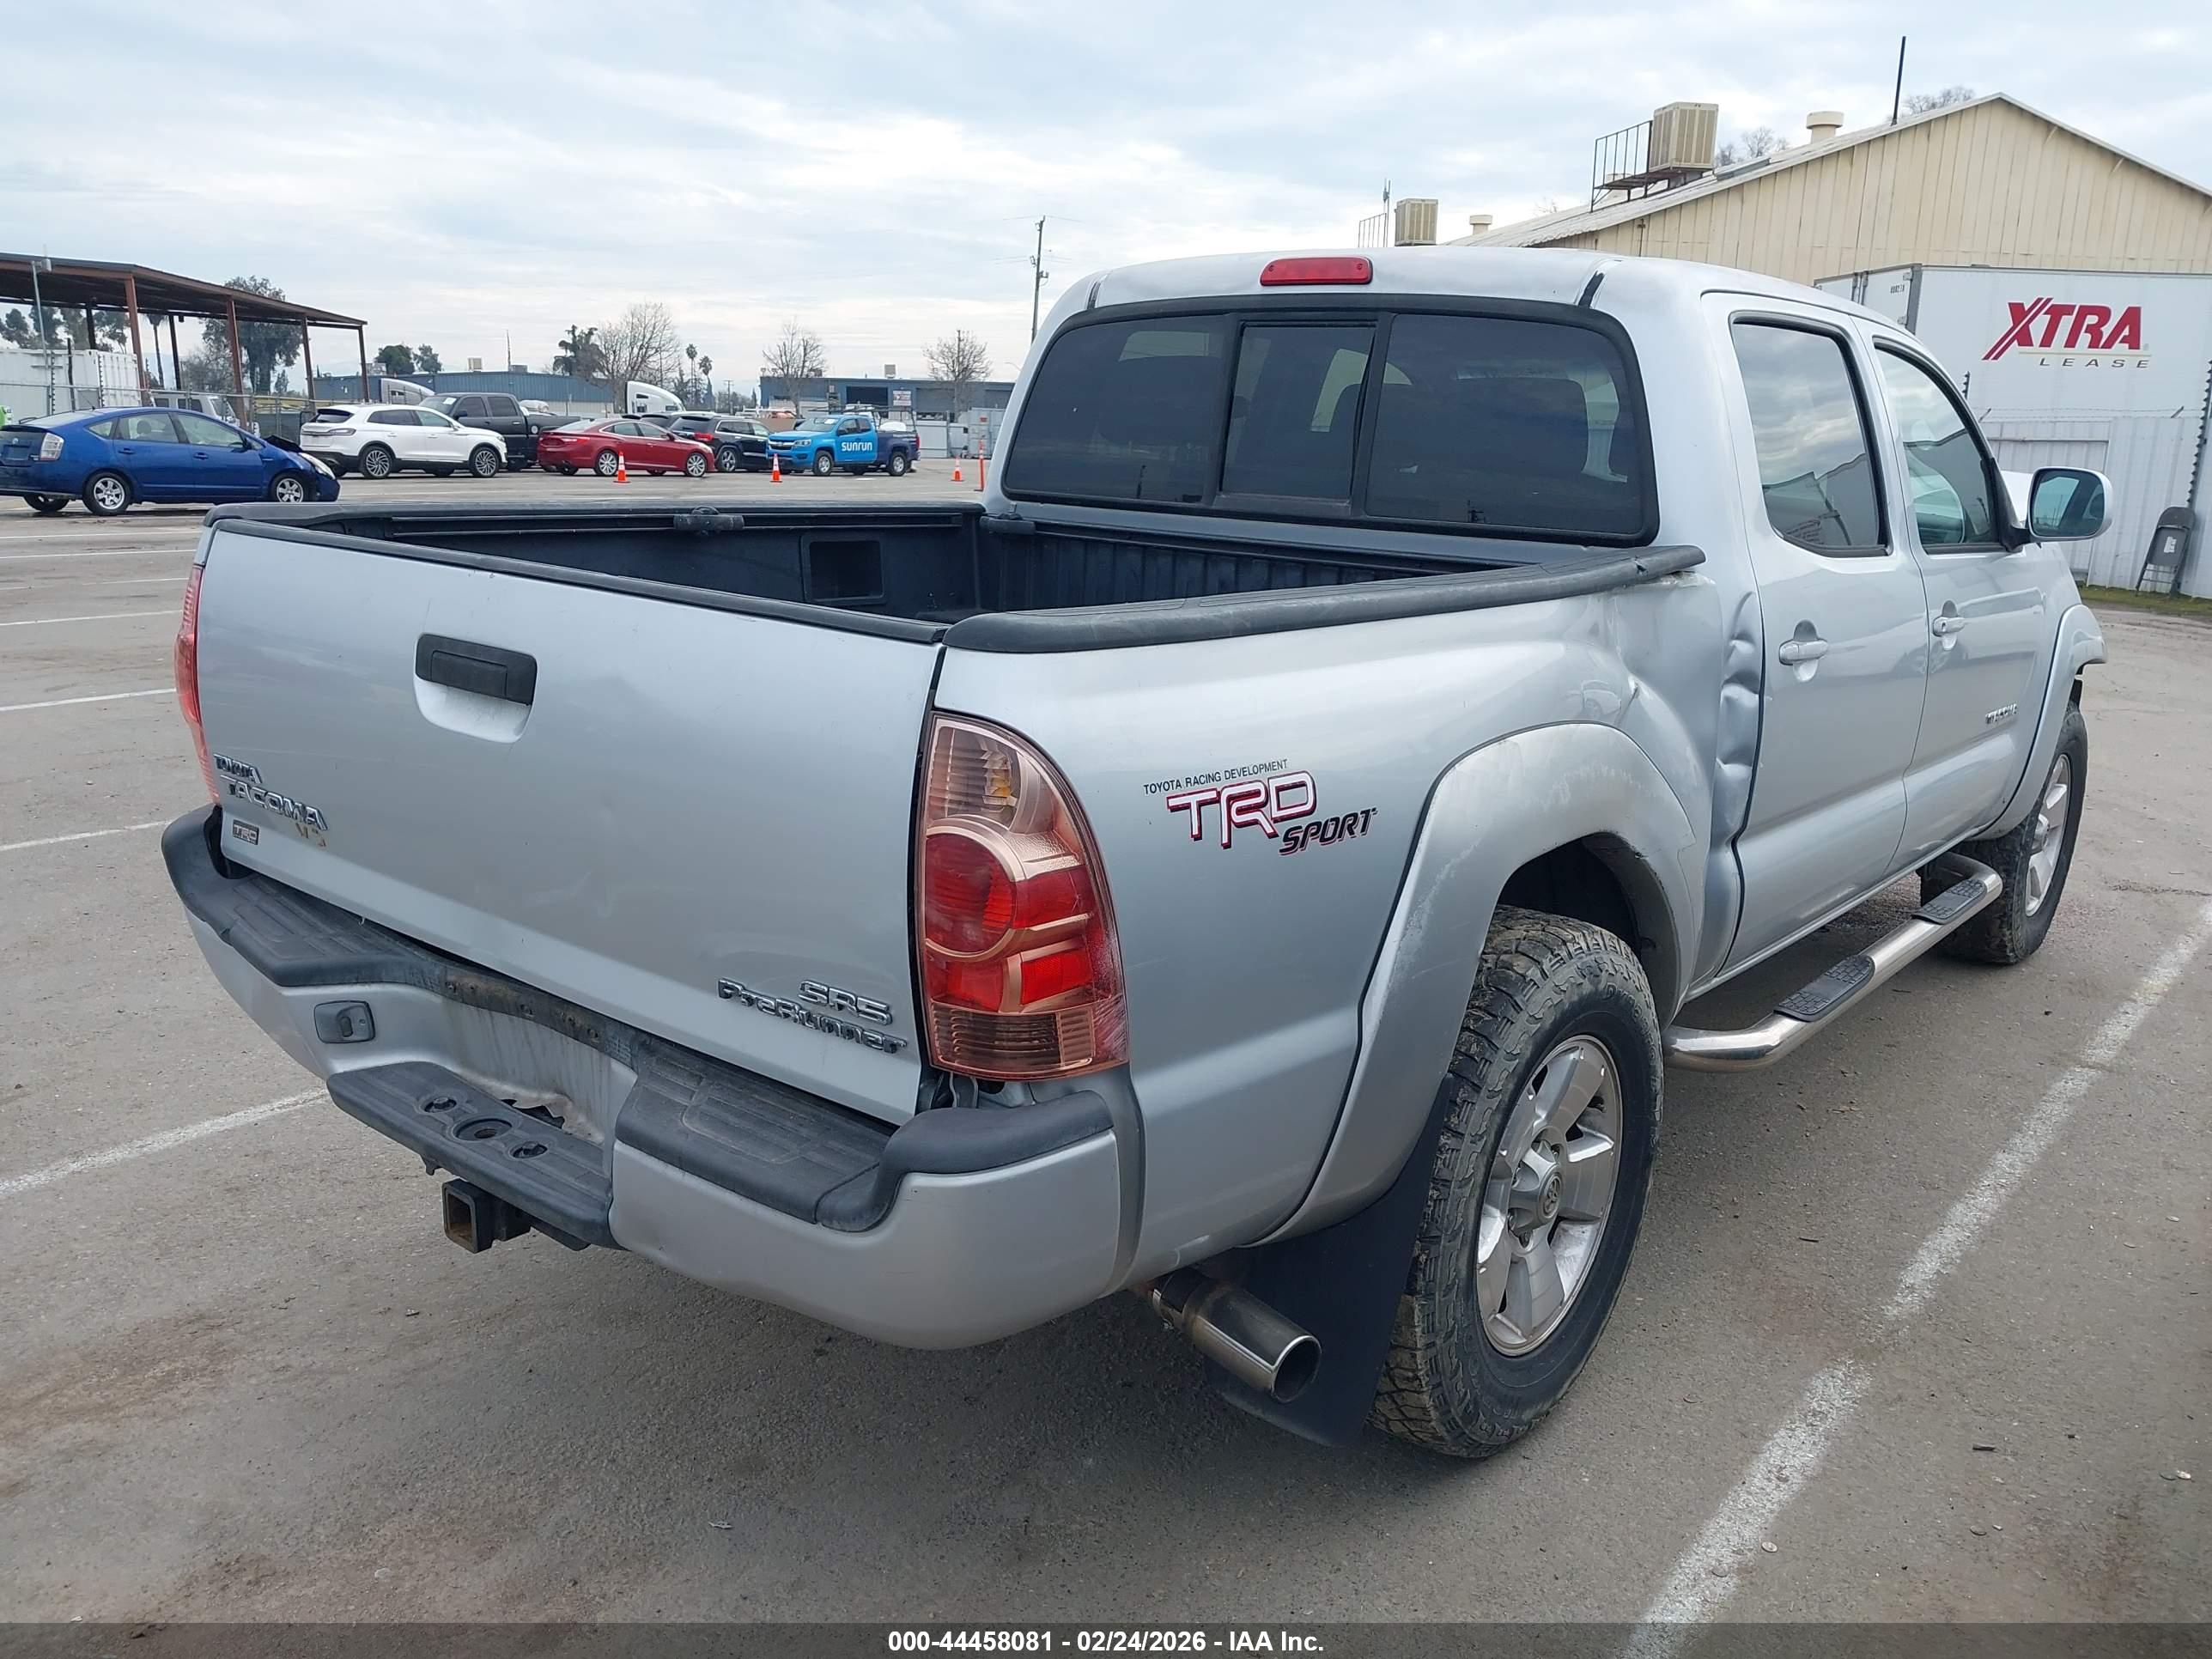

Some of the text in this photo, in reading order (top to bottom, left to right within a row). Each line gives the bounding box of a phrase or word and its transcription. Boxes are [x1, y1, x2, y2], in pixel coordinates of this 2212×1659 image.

[1981, 297, 2142, 361] XTRA
[2039, 357, 2150, 368] LEASE
[213, 753, 263, 785] TOYOTA
[1143, 759, 1288, 795] TOYOTA RACING DEVELOPMENT
[220, 775, 329, 831] TACOMA
[1165, 769, 1318, 850] TRD
[1278, 807, 1378, 856] SPORT
[798, 979, 893, 1025] SR5
